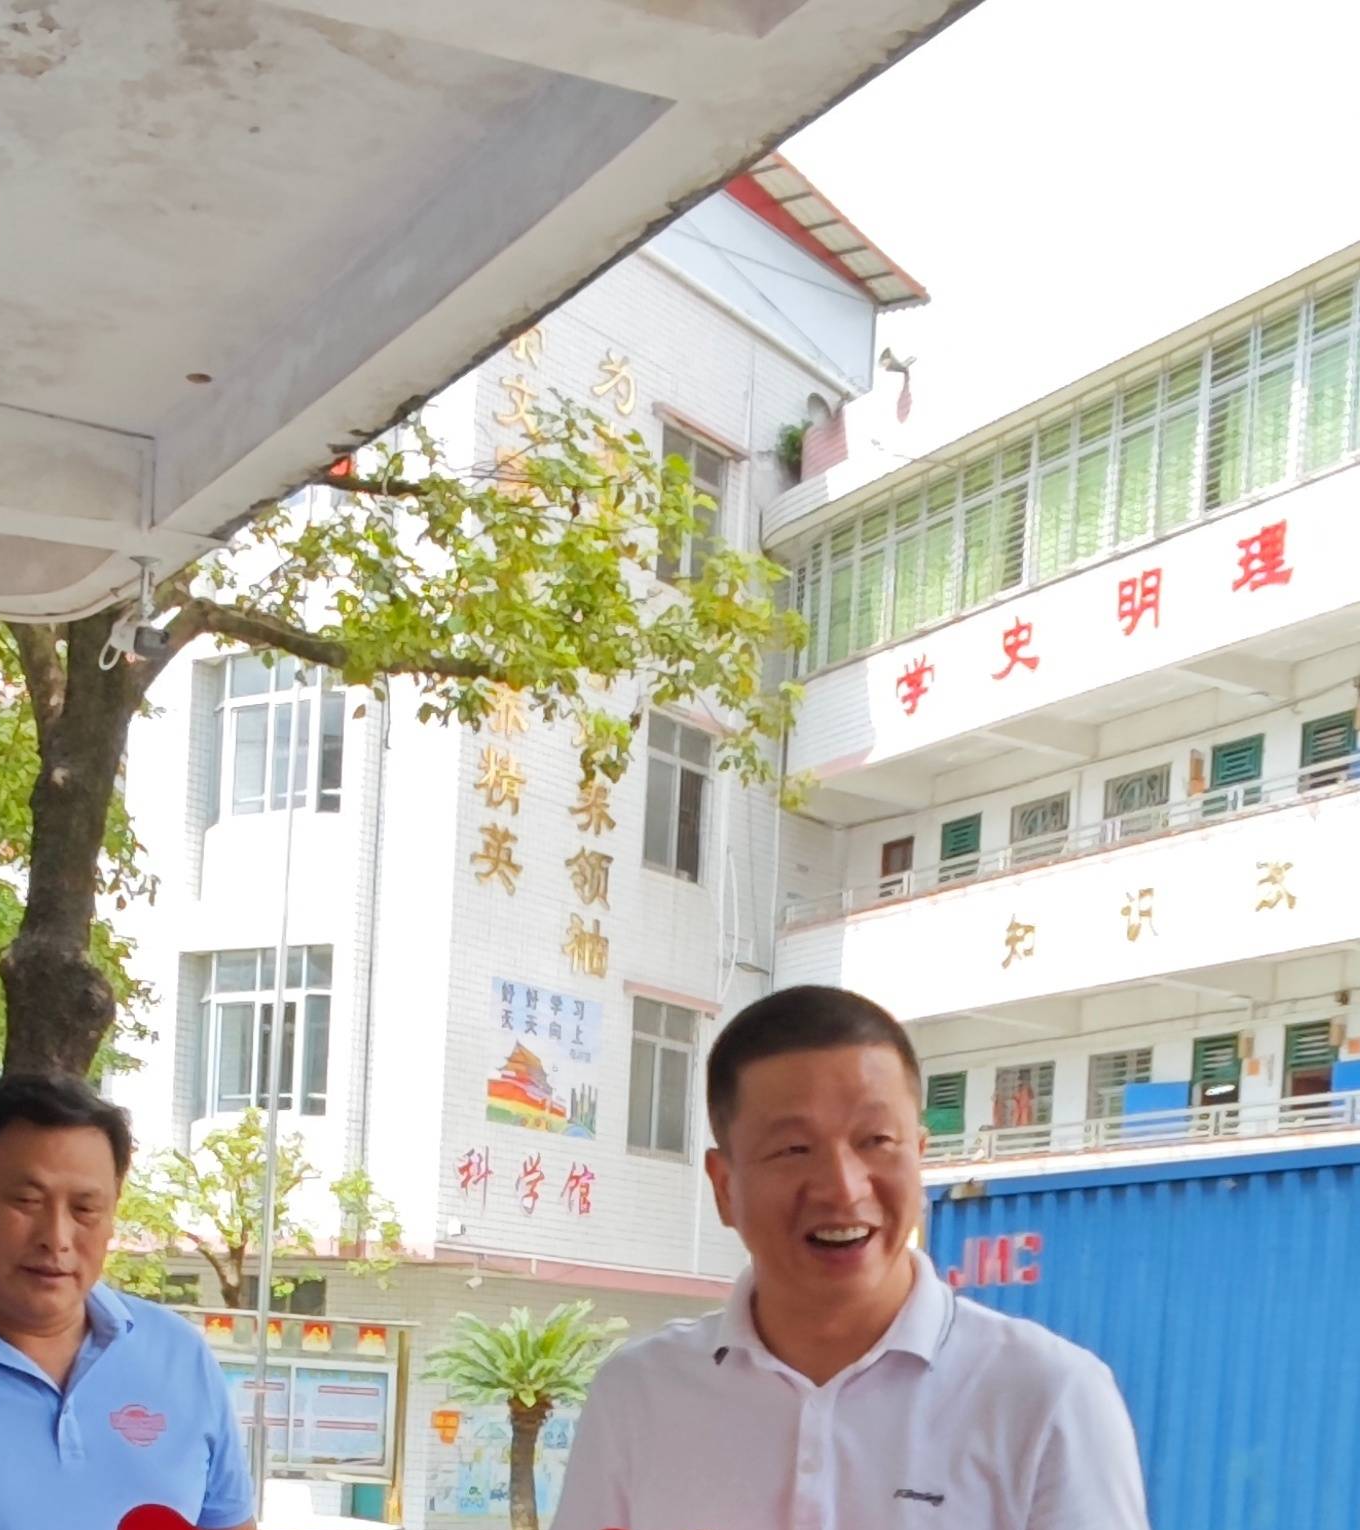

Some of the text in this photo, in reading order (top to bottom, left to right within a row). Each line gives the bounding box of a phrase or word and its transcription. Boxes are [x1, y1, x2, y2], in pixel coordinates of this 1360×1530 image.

[501, 981, 586, 1021] 好好学习
[500, 1009, 585, 1046] 天天向上
[457, 1146, 597, 1216] 科学馆
